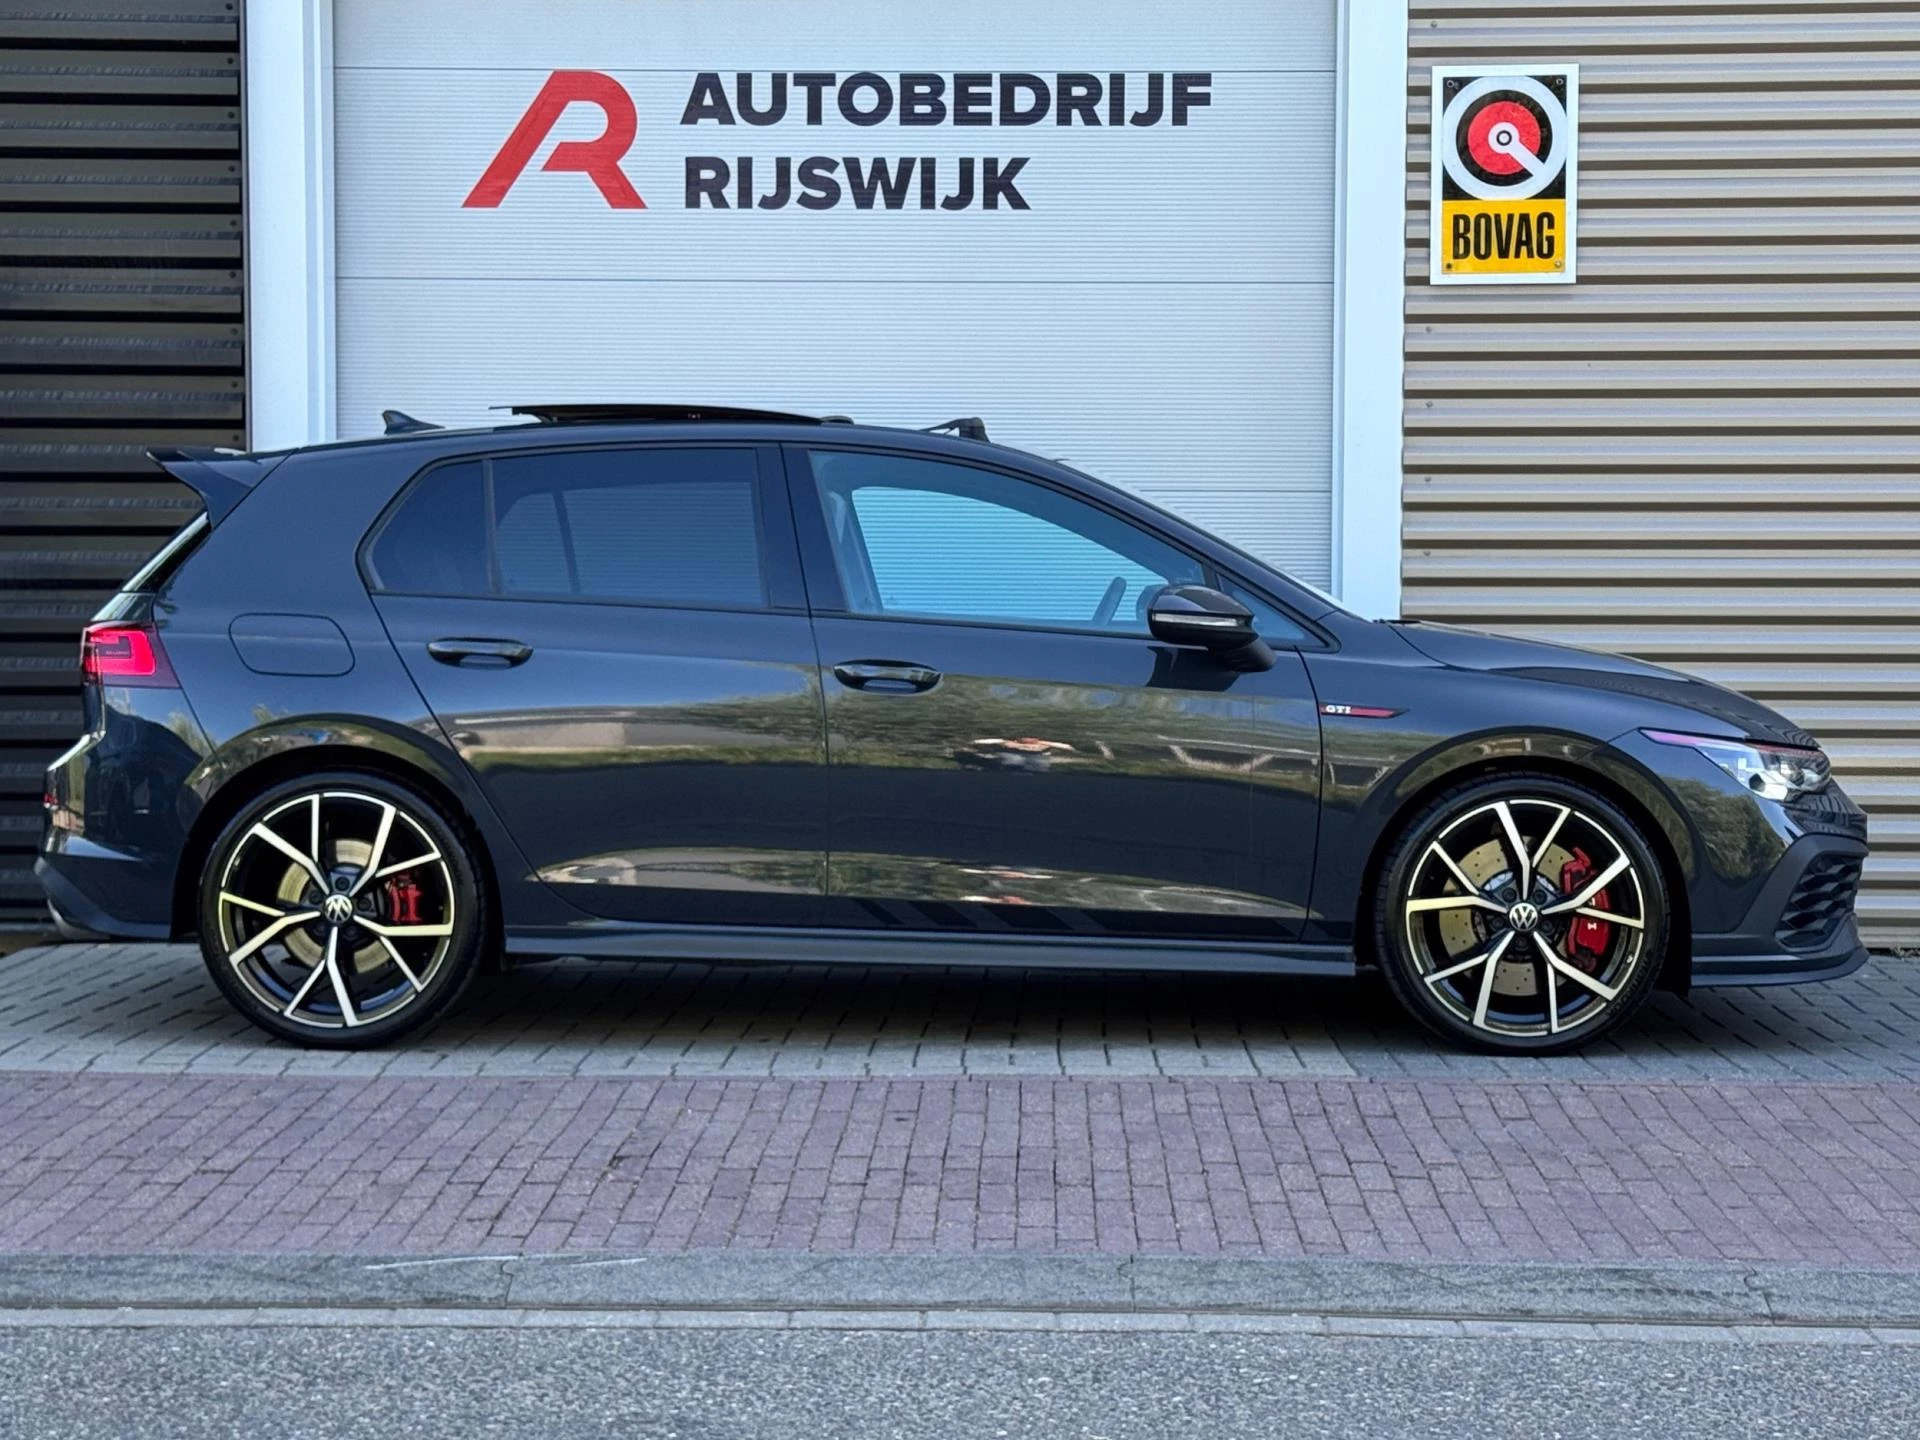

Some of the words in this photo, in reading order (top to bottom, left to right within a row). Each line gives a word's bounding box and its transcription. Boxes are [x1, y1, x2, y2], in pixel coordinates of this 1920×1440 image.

[681, 71, 1212, 126] AUTOBEDRIJF
[685, 156, 1031, 211] RIJSWIJK
[1453, 211, 1554, 260] BOVAG
[1325, 704, 1351, 714] GTI
